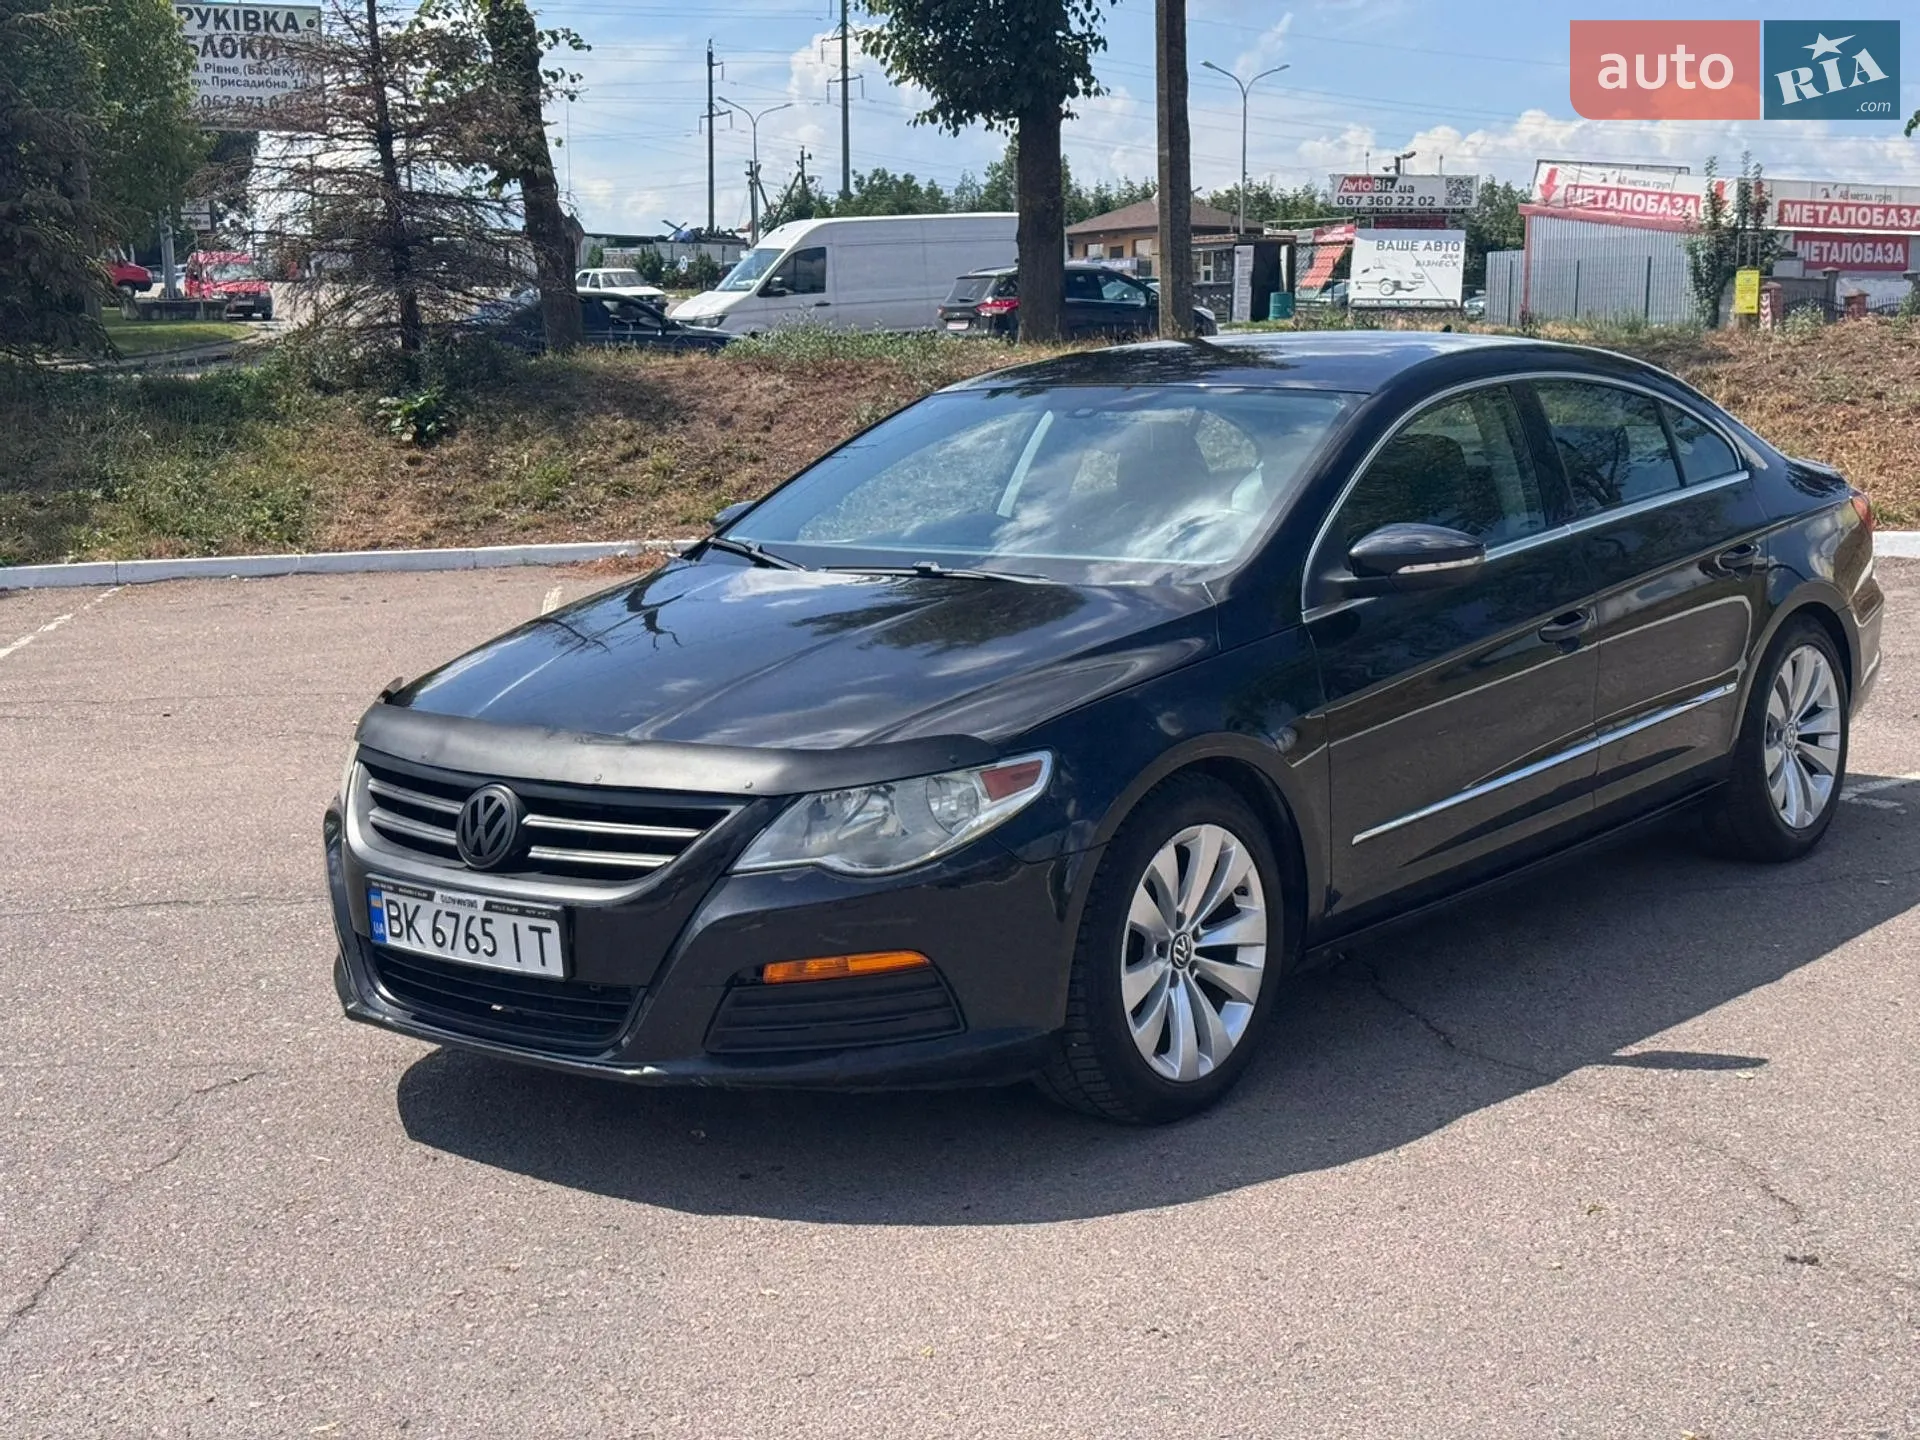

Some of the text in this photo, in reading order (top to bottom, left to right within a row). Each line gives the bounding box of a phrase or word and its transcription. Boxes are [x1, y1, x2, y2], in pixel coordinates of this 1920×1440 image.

[1337, 195, 1436, 207] 067 360 22 02
[1566, 186, 1697, 219] МЕТАЛОБАЗА
[1376, 240, 1461, 252] ВАШЕ АВТО
[1797, 240, 1905, 265] МЕТАЛОБАЗА
[384, 897, 424, 945] BK
[432, 909, 497, 958] 6765
